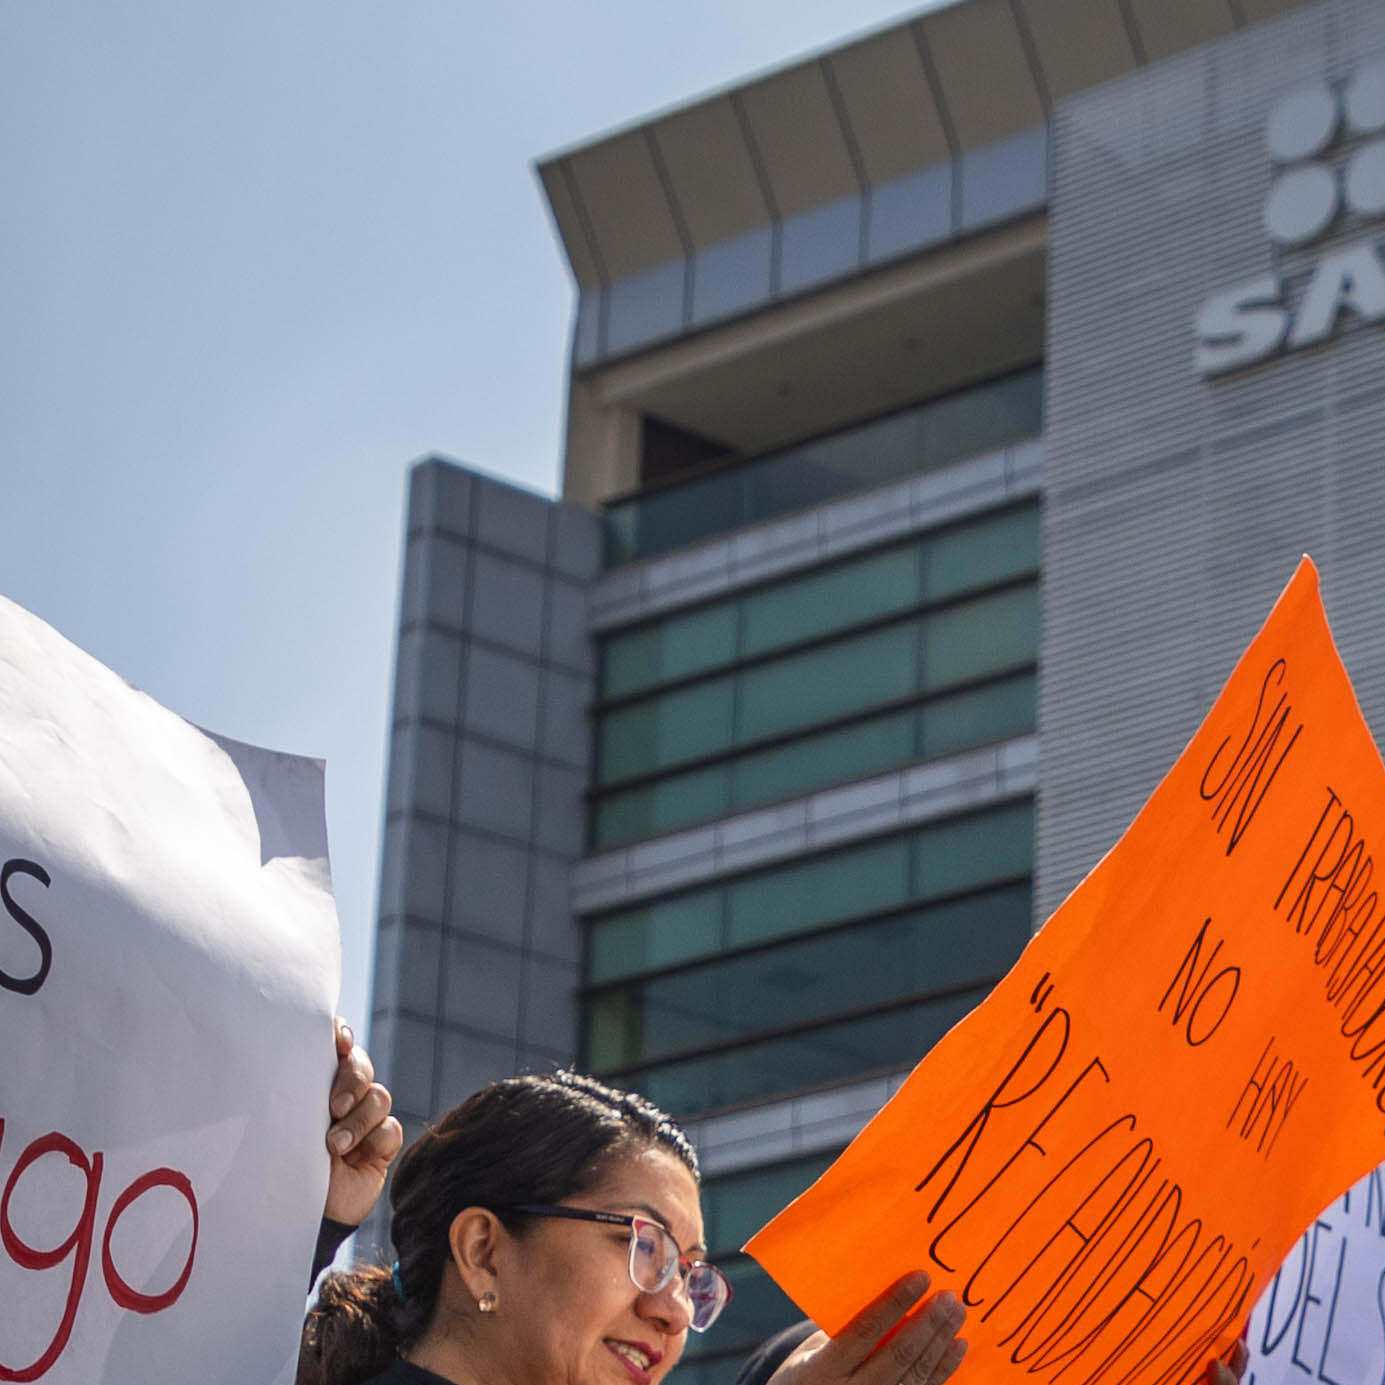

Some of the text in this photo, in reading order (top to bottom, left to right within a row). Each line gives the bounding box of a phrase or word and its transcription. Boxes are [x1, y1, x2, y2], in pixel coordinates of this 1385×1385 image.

[1199, 658, 1304, 856] SIN
[1157, 916, 1309, 1162] NO HAY
[0, 1116, 199, 1383] go
